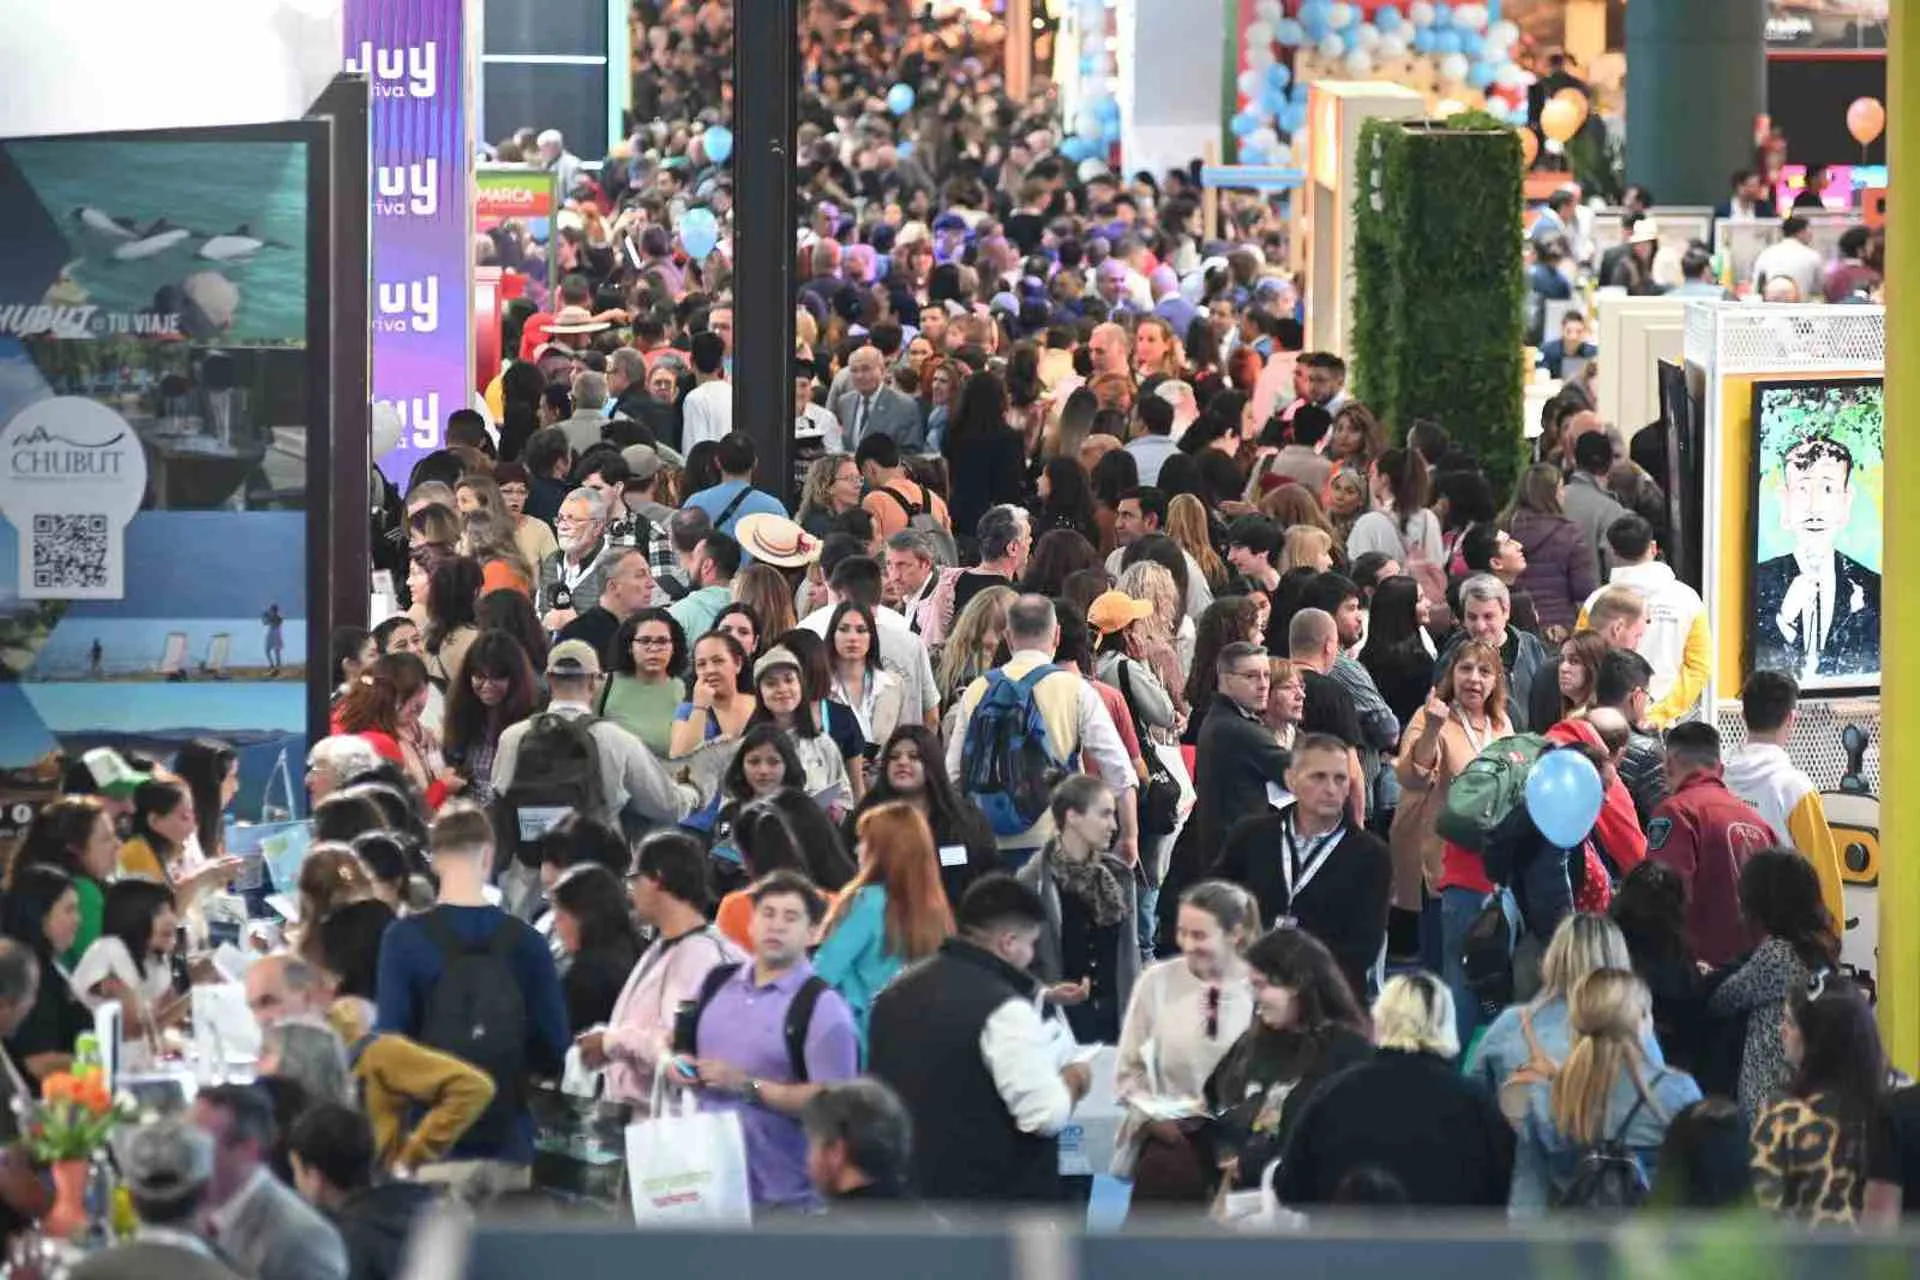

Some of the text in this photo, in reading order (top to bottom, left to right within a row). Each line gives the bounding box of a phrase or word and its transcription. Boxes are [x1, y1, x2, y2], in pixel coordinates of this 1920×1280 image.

[107, 313, 129, 333] TU
[133, 312, 181, 334] VIAJE
[11, 451, 124, 474] CHUBUT
